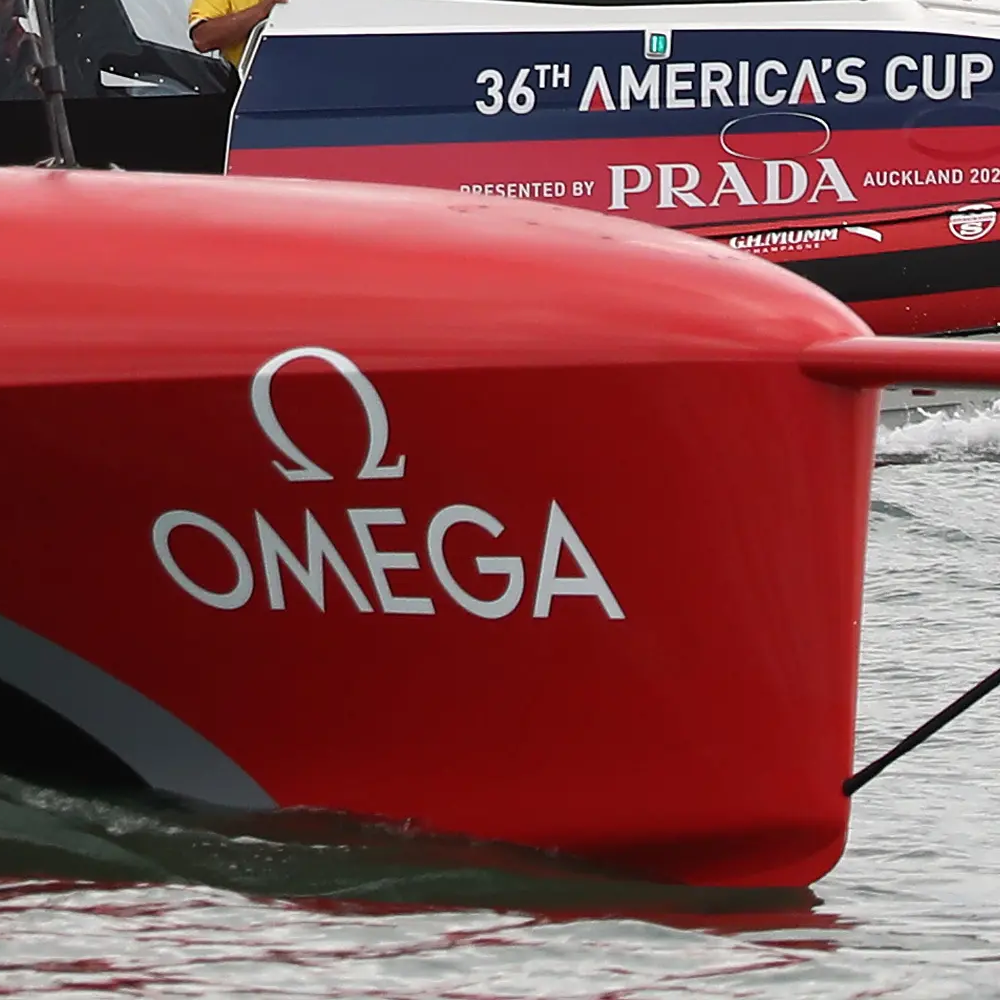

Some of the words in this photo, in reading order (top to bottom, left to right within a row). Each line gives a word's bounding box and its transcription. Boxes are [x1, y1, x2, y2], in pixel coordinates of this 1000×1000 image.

[475, 64, 570, 115] 36TH
[579, 57, 867, 112] AMERICA'S
[885, 53, 994, 102] CUP
[572, 181, 595, 196] BY
[607, 158, 858, 210] PRADA
[863, 169, 963, 187] AUCKLAND
[747, 242, 821, 254] HAMPAGNE
[152, 499, 626, 620] OMEGA
